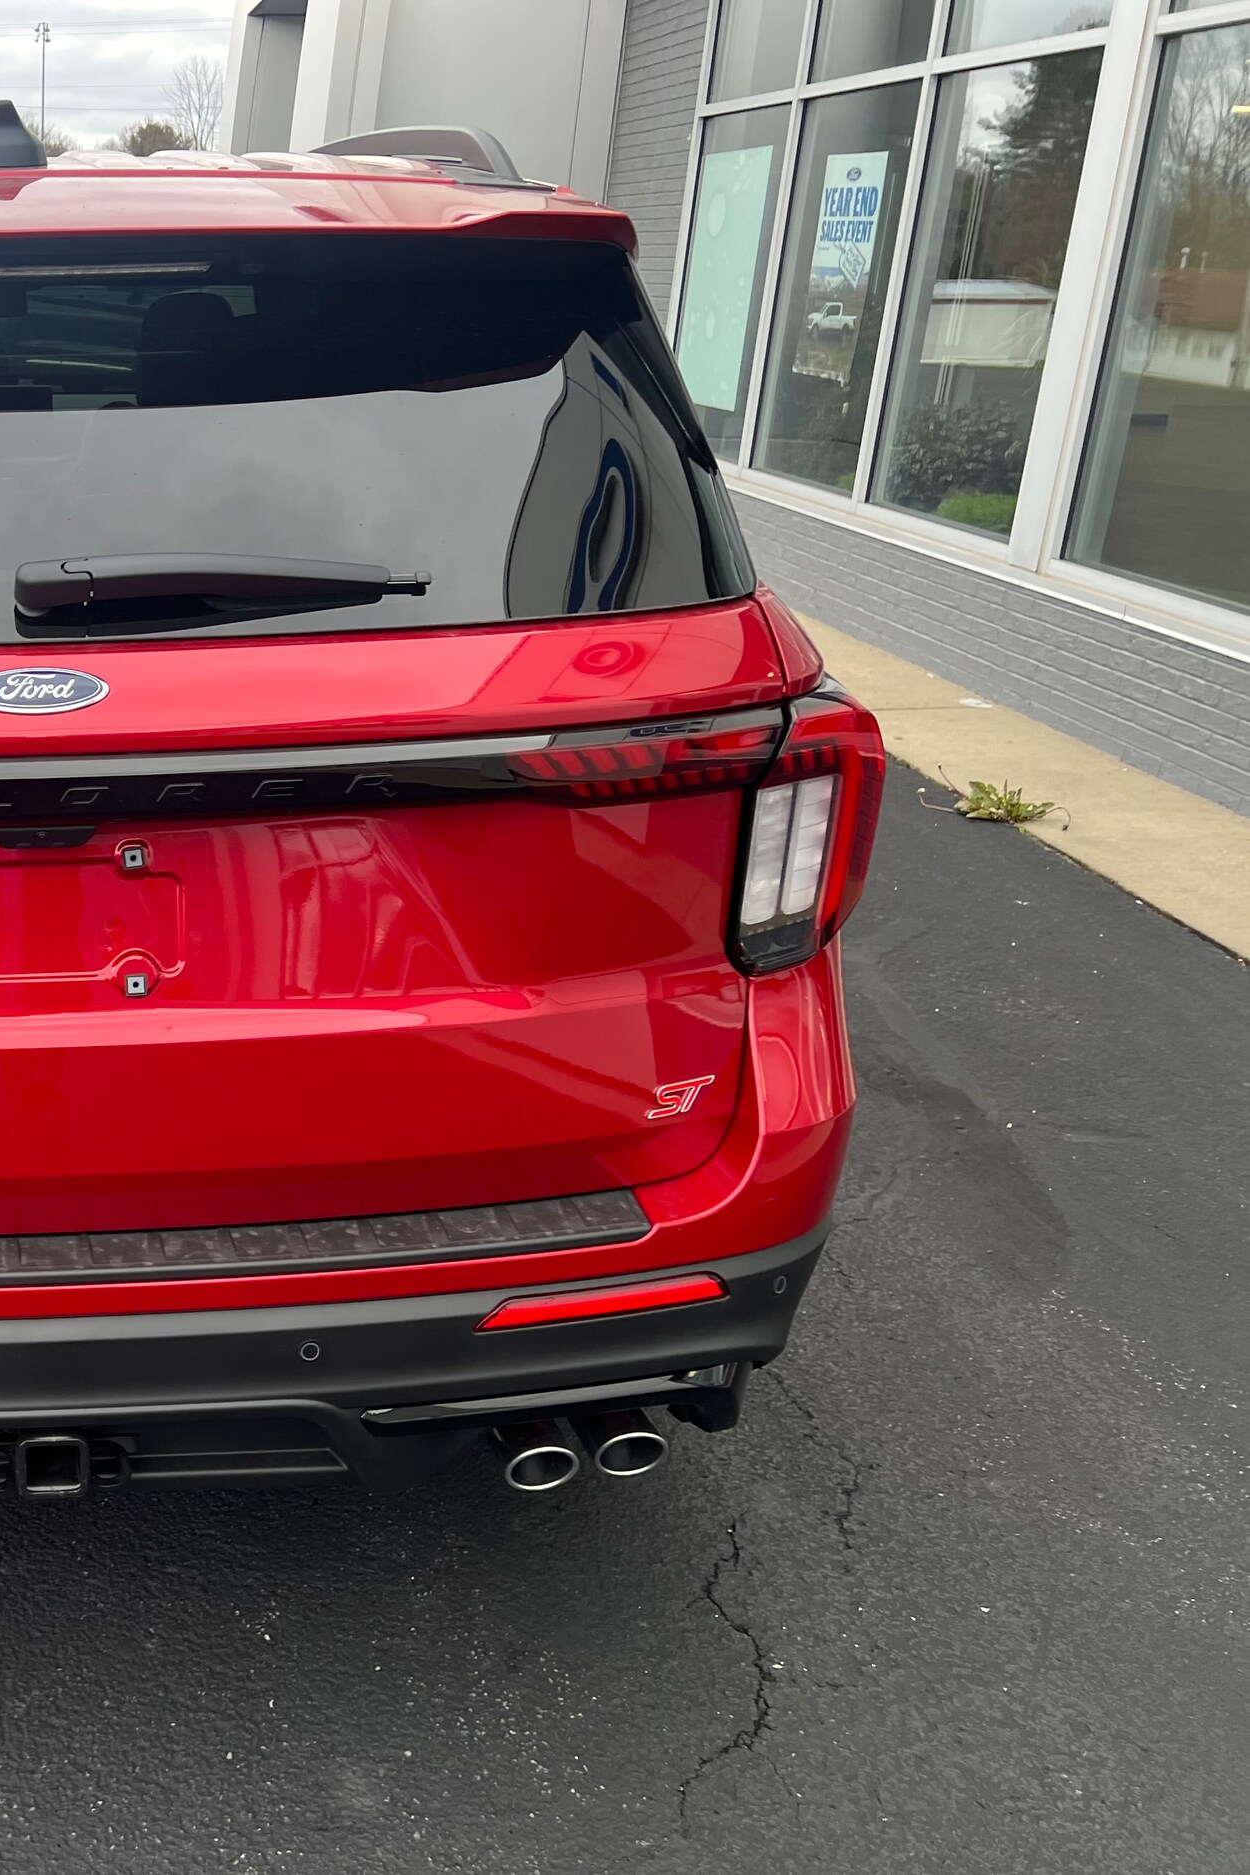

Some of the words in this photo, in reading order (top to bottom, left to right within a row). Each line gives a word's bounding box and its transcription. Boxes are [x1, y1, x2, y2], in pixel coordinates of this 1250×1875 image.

[823, 187, 853, 217] YEAR
[853, 186, 879, 217] END
[820, 220, 846, 242] SALES
[845, 220, 874, 243] EVENT
[0, 673, 75, 700] Ford
[647, 1074, 715, 1119] ST
